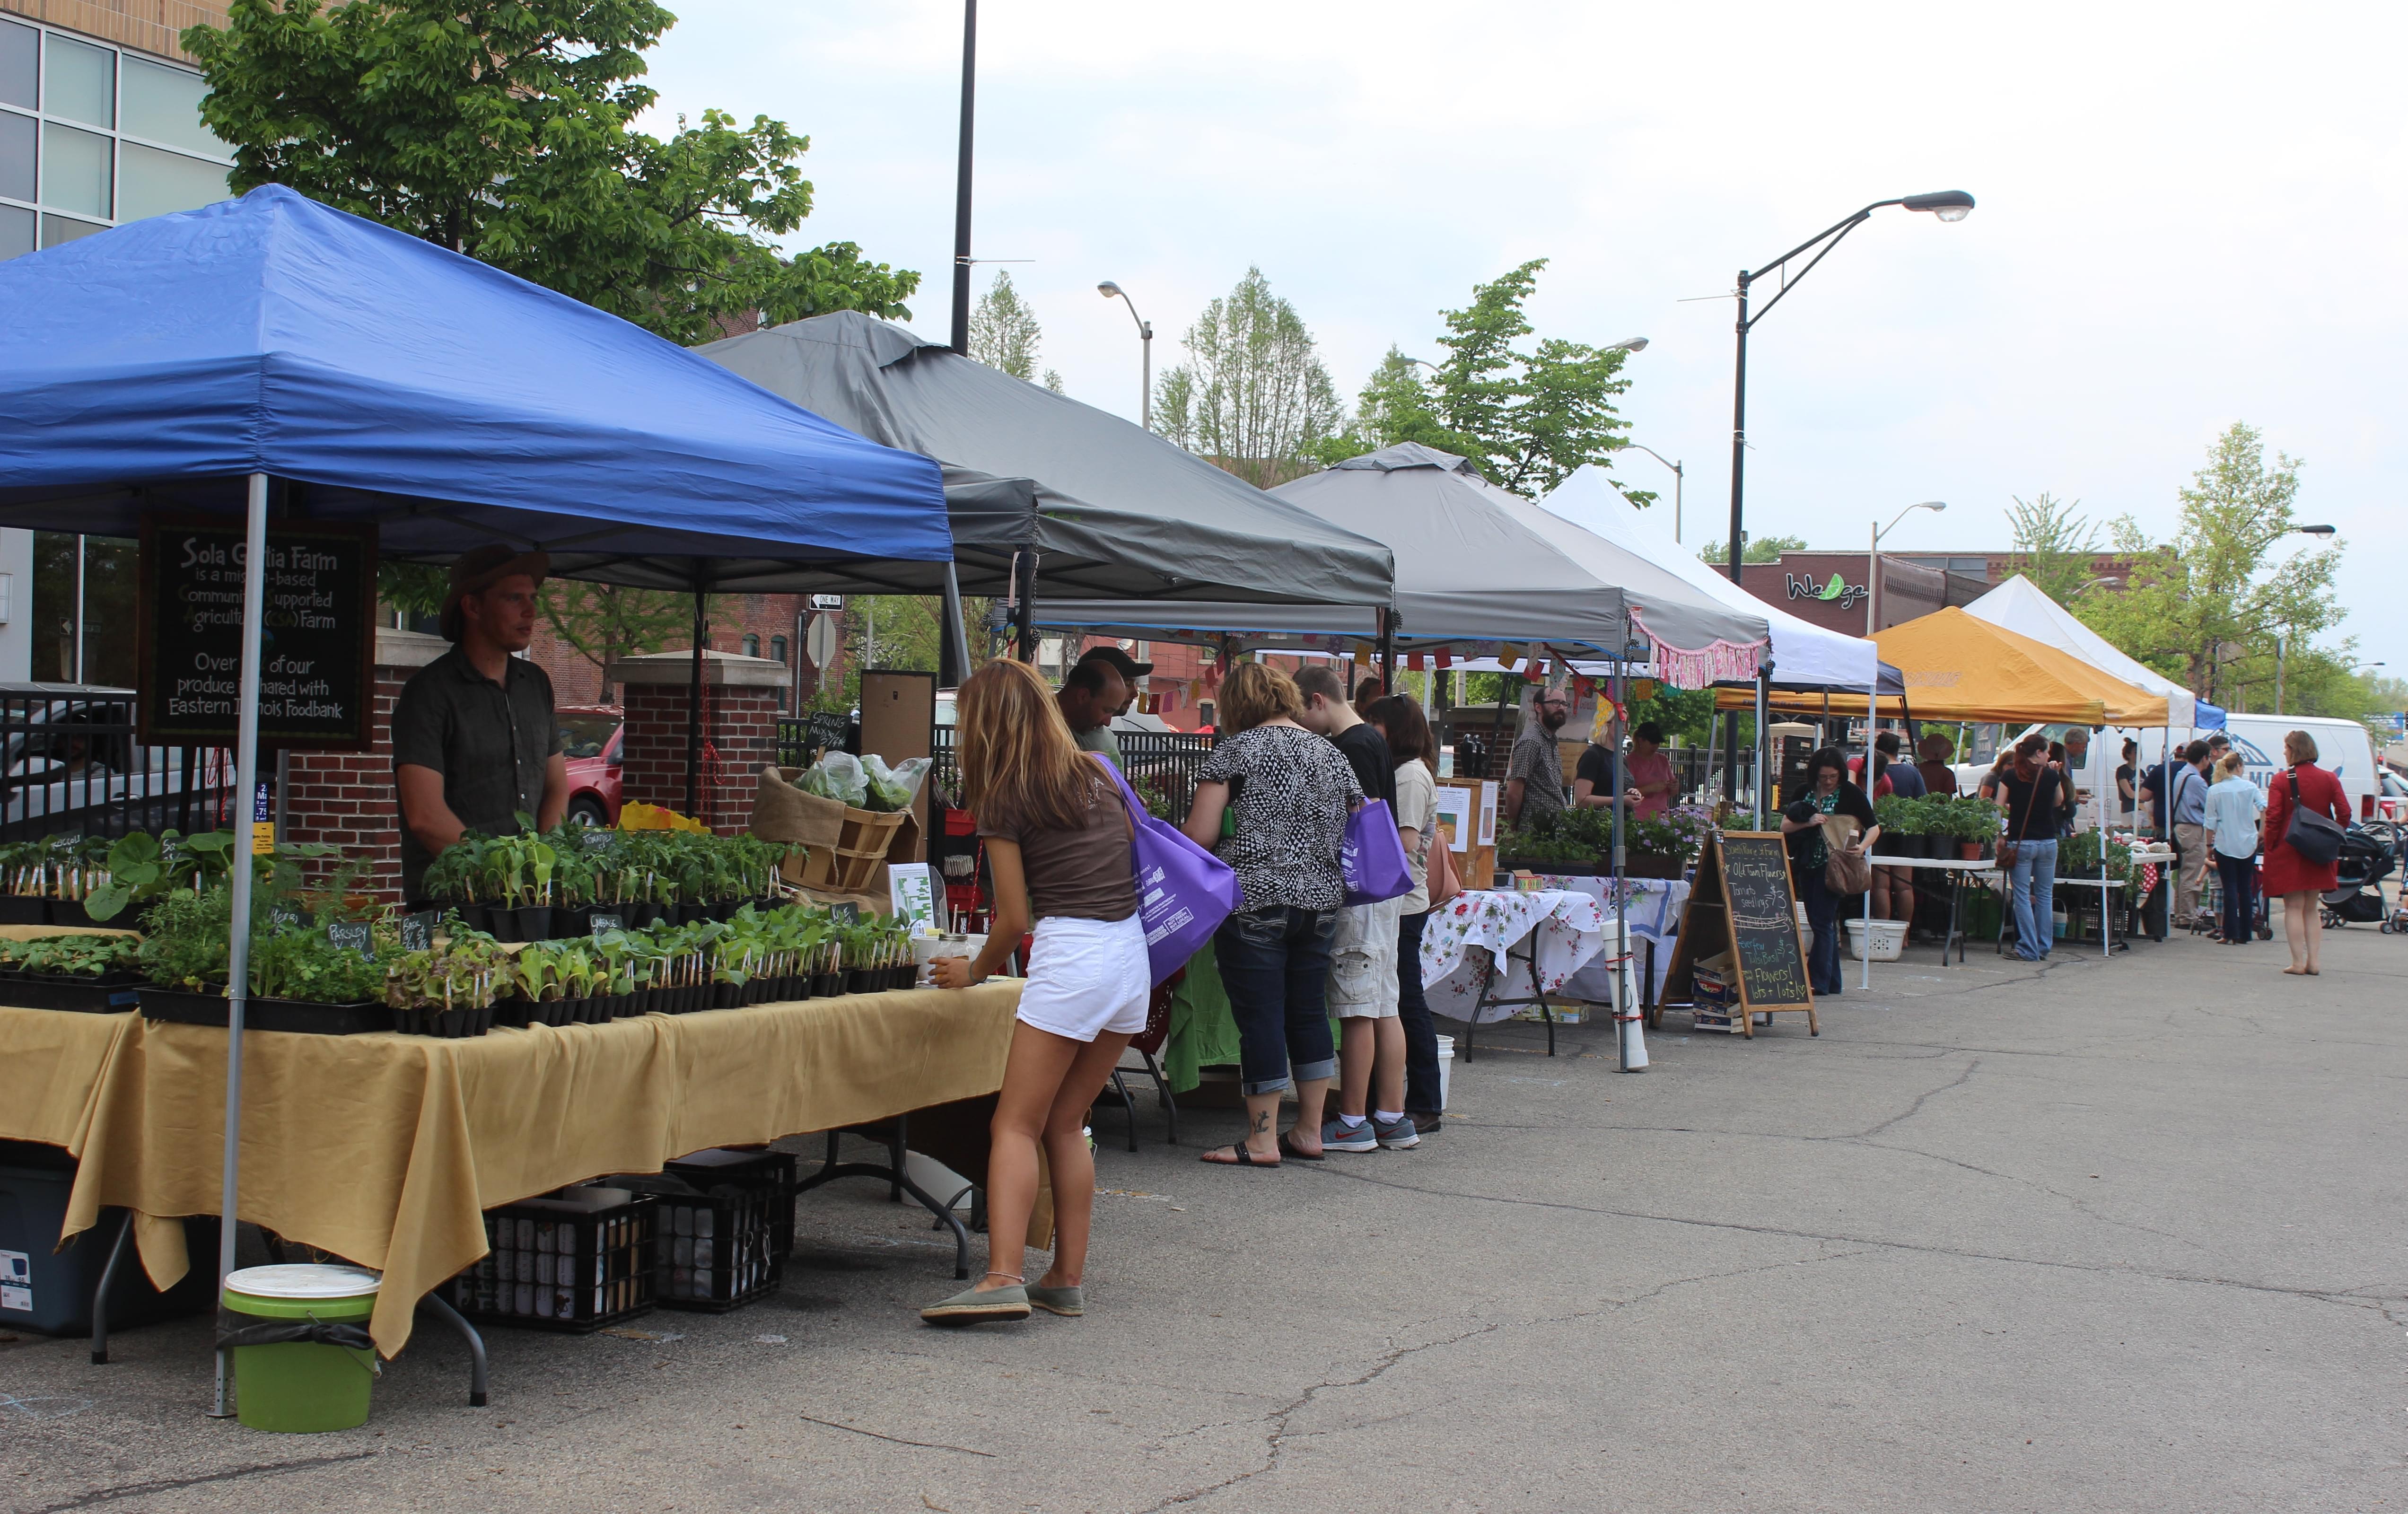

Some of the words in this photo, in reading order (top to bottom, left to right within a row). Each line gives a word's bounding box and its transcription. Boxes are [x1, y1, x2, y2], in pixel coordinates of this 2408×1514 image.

[181, 537, 226, 568] Sola
[231, 542, 285, 568] Gtia
[290, 546, 338, 570] Farm
[195, 567, 207, 581] is
[210, 569, 220, 582] a
[224, 569, 316, 586] misn-based
[177, 583, 246, 604] Communi
[265, 589, 333, 610] Supported
[820, 595, 829, 604] ONE
[831, 596, 840, 604] WAY
[183, 604, 245, 632] Agricultu
[264, 610, 298, 628] (CSA)
[300, 610, 336, 629] Farm
[194, 652, 238, 671] Over
[269, 654, 286, 674] of
[287, 659, 315, 674] our
[177, 674, 236, 697] produce
[259, 677, 297, 696] hared
[299, 678, 330, 697] with
[168, 696, 231, 716] Eastern
[233, 698, 282, 718] Inois
[285, 699, 344, 719] Foodbank
[813, 711, 846, 728] SPRING
[809, 726, 827, 735] MIX
[1733, 862, 1747, 877] Old
[1744, 864, 1760, 877] Town
[1758, 863, 1783, 883] Flowers
[1728, 882, 1756, 896] Tomato
[1741, 895, 1769, 914] seedlings
[329, 925, 367, 942] PARSLEY
[1147, 928, 1167, 943] GROUND
[1761, 952, 1779, 965] Basil
[1751, 984, 1767, 1000] lots
